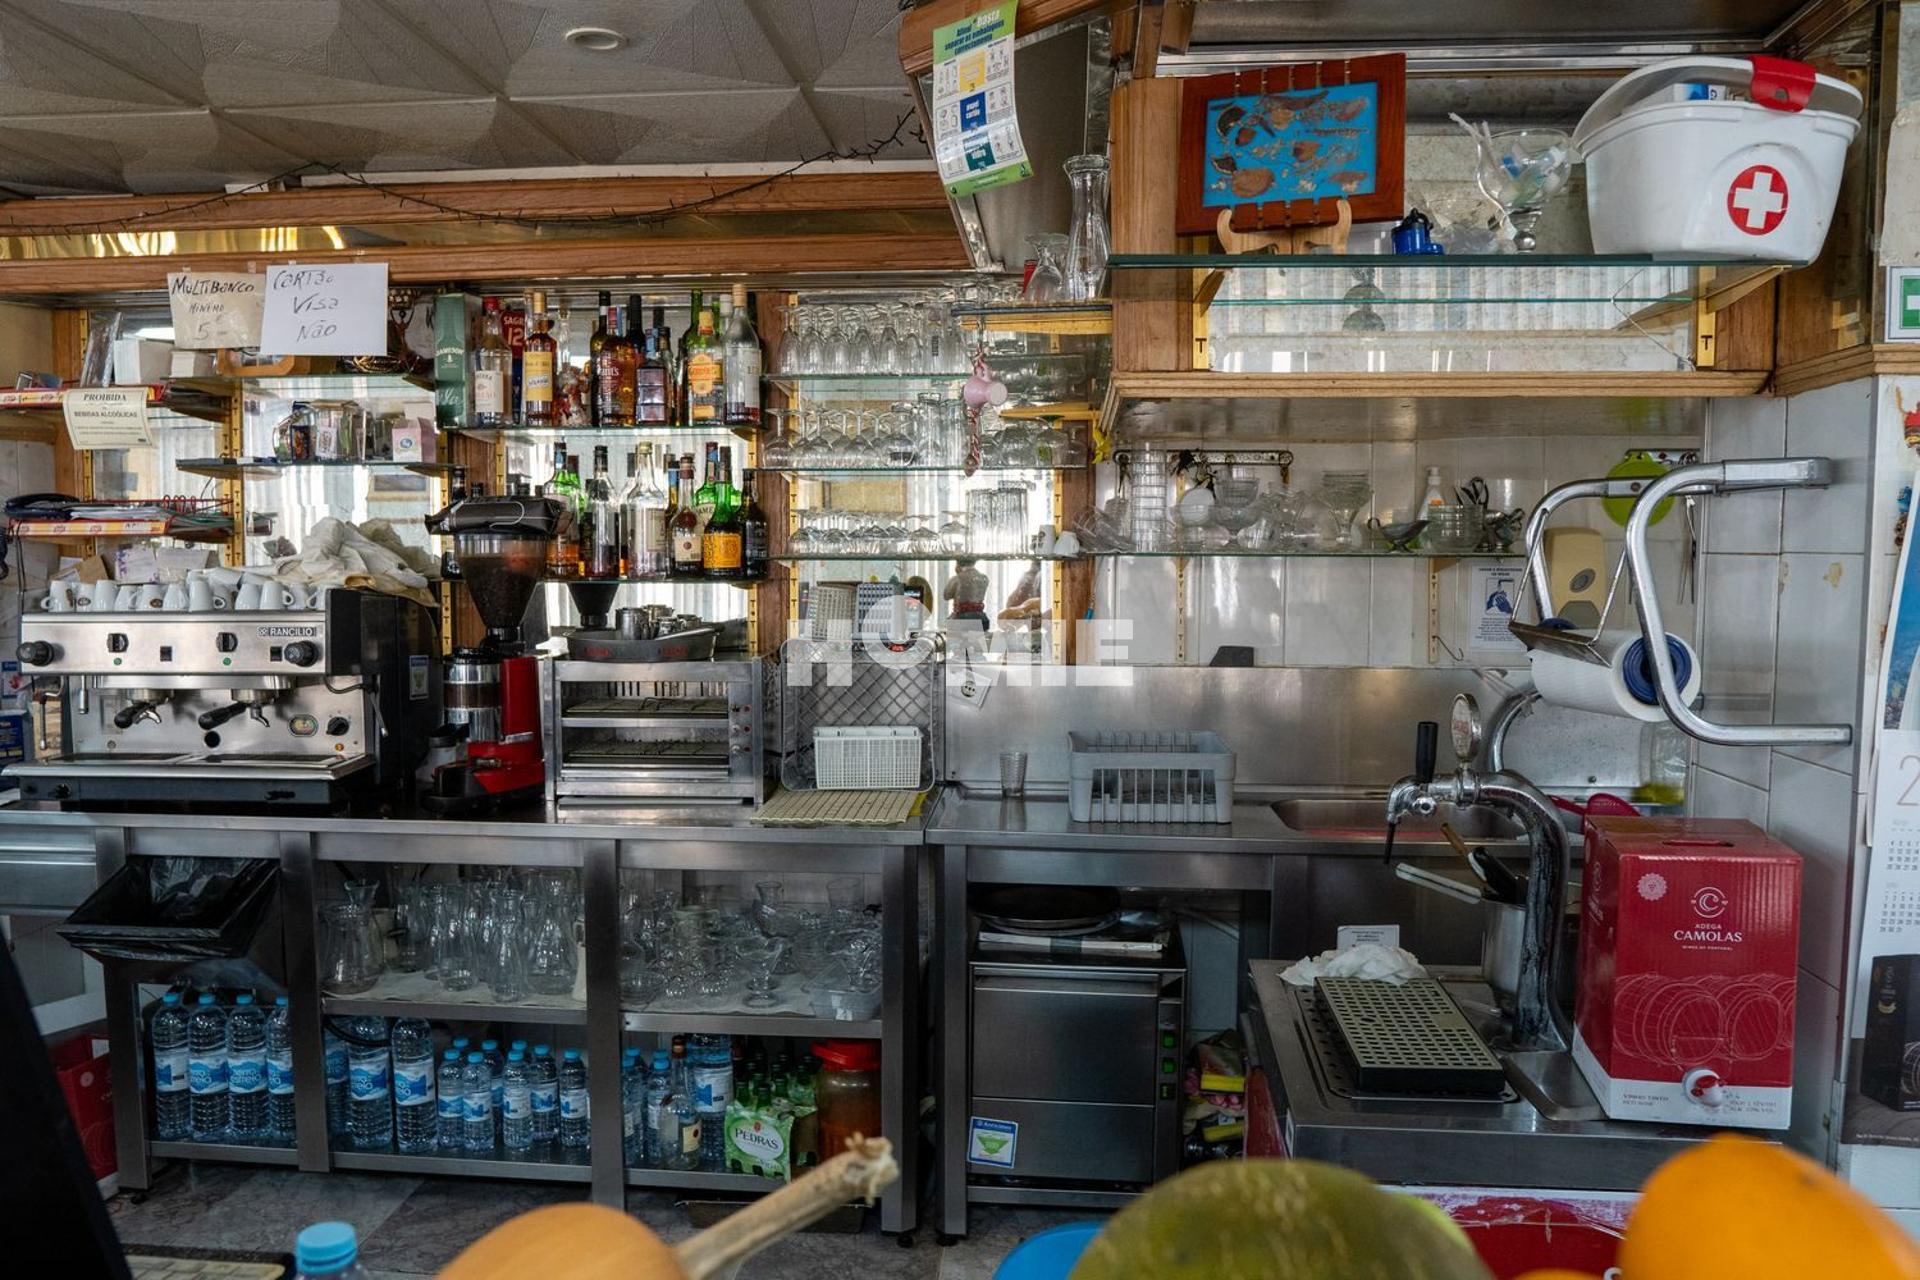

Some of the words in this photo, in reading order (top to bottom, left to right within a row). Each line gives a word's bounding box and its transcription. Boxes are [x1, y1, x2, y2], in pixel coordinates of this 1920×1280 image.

[508, 327, 524, 346] 12
[84, 392, 127, 402] PROIBIDA
[269, 627, 314, 636] RANCILIO
[1673, 929, 1743, 944] CAMOLAS
[735, 1127, 779, 1150] PEDRAS
